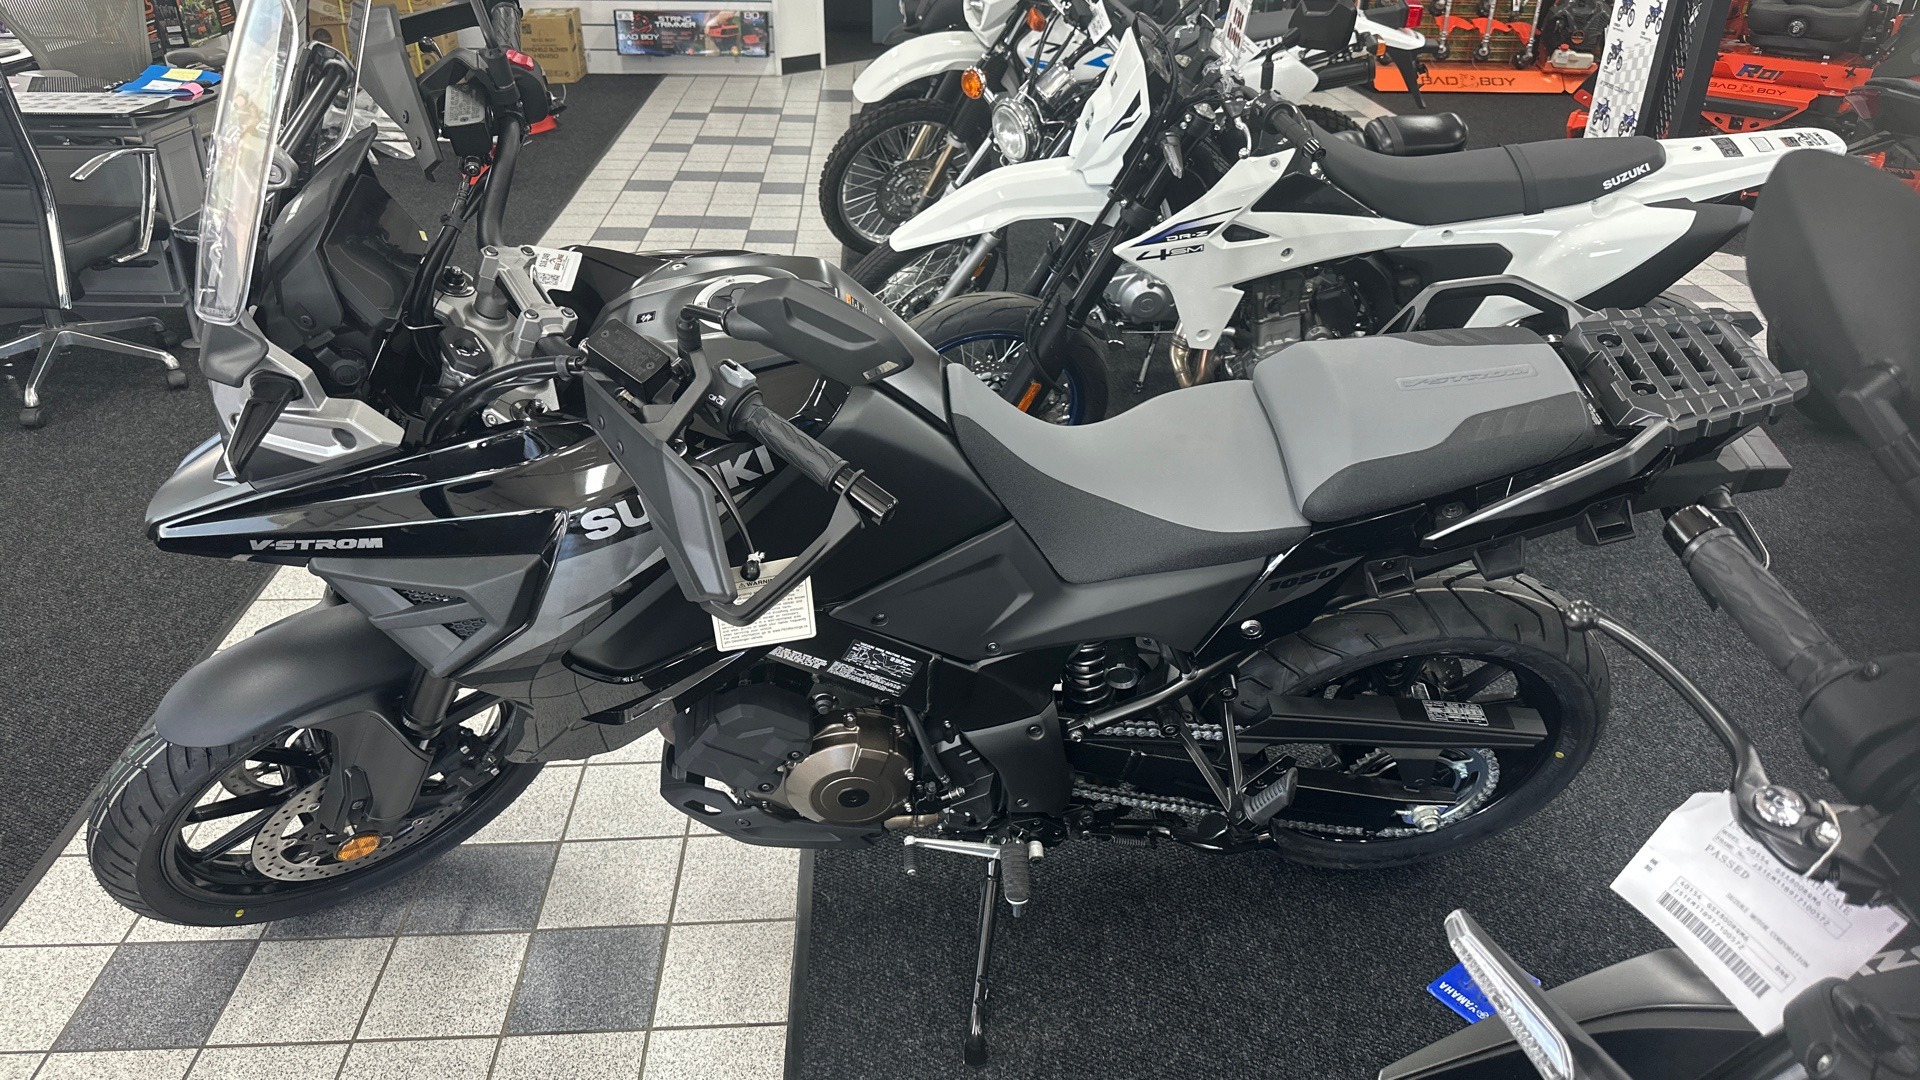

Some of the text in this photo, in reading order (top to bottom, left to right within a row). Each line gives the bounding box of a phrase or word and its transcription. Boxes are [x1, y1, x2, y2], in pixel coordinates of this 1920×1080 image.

[1420, 76, 1516, 87] BAD BOY
[1709, 81, 1787, 96] BAD BOY
[1602, 162, 1651, 190] SUZUKI
[580, 445, 775, 540] SUKI
[250, 538, 384, 551] V-STROM
[746, 578, 774, 588] WARNI
[1268, 568, 1338, 592] 1050
[1704, 844, 1750, 880] PASSED
[1678, 879, 1703, 901] 40154
[1438, 979, 1478, 1013] YAMAHA
